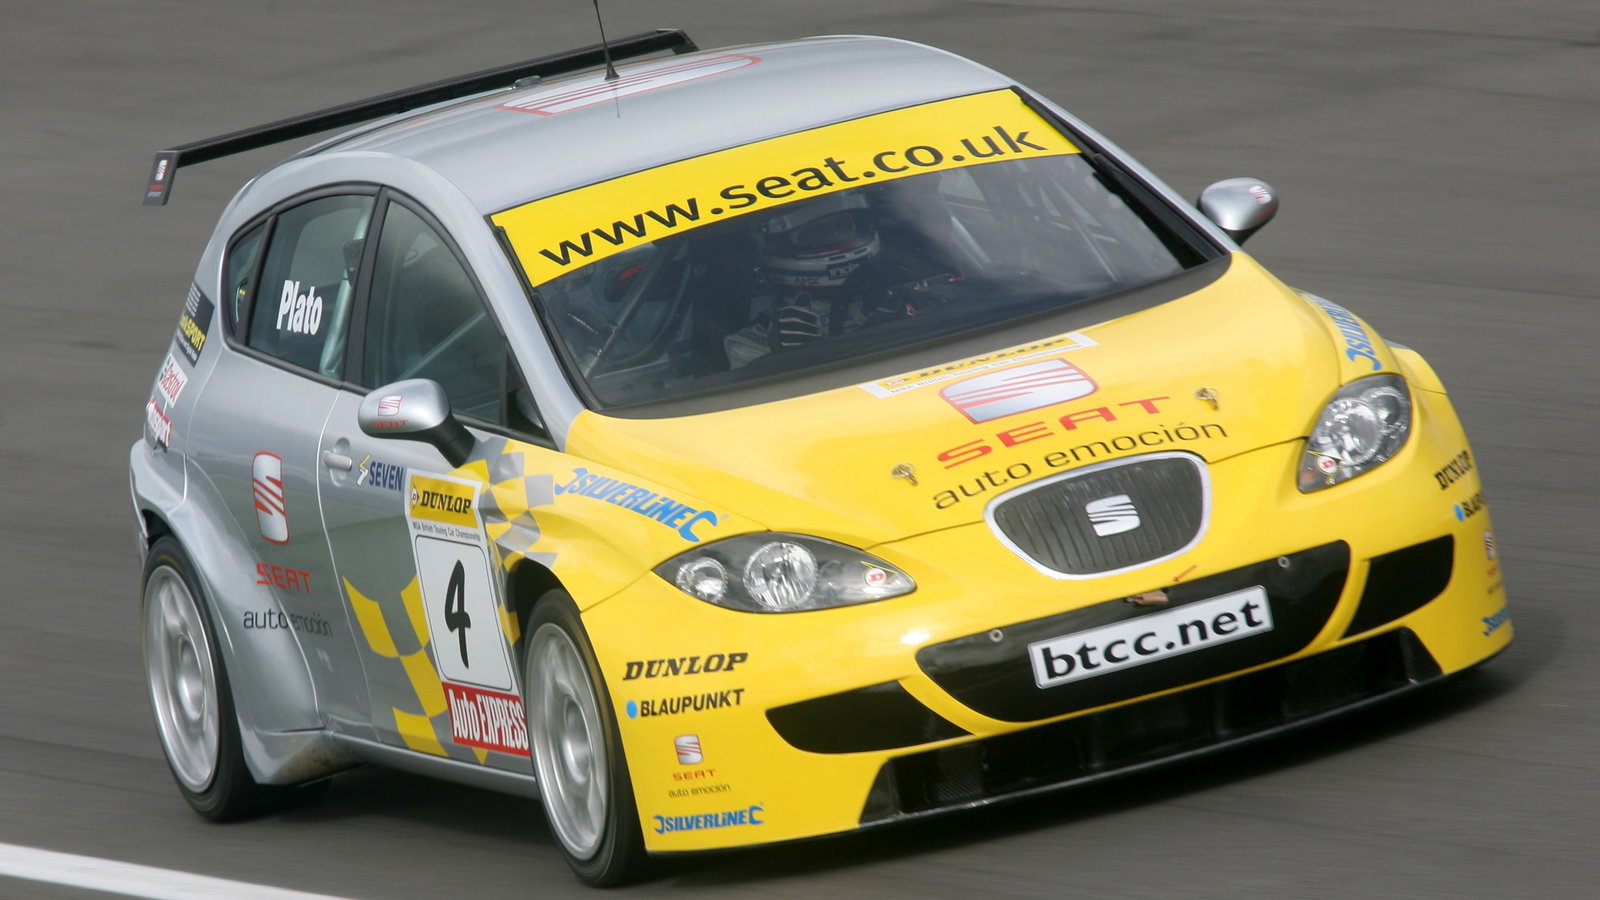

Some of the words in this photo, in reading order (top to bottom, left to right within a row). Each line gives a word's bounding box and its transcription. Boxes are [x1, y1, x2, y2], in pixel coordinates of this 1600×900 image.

[537, 124, 1048, 267] www.seat.co.uk
[275, 279, 323, 336] Plato
[370, 419, 409, 429] SEAT
[936, 395, 1172, 469] SEAT
[368, 460, 404, 491] SEVEN
[931, 462, 1032, 510] auto
[1043, 421, 1229, 468] emoción
[1433, 450, 1472, 490] DUNLOP
[420, 490, 472, 514] DUNLOP
[256, 562, 312, 593] SEAT
[243, 607, 289, 630] auto
[444, 559, 472, 670] 4
[1040, 600, 1263, 680] btcc.net
[622, 652, 749, 681] DUNLOP
[640, 688, 745, 718] BLAUPUNKT
[448, 688, 481, 743] Auto
[476, 693, 530, 751] EXPRESS
[672, 768, 716, 781] SEAT
[668, 788, 690, 798] auto
[691, 783, 732, 797] emoción
